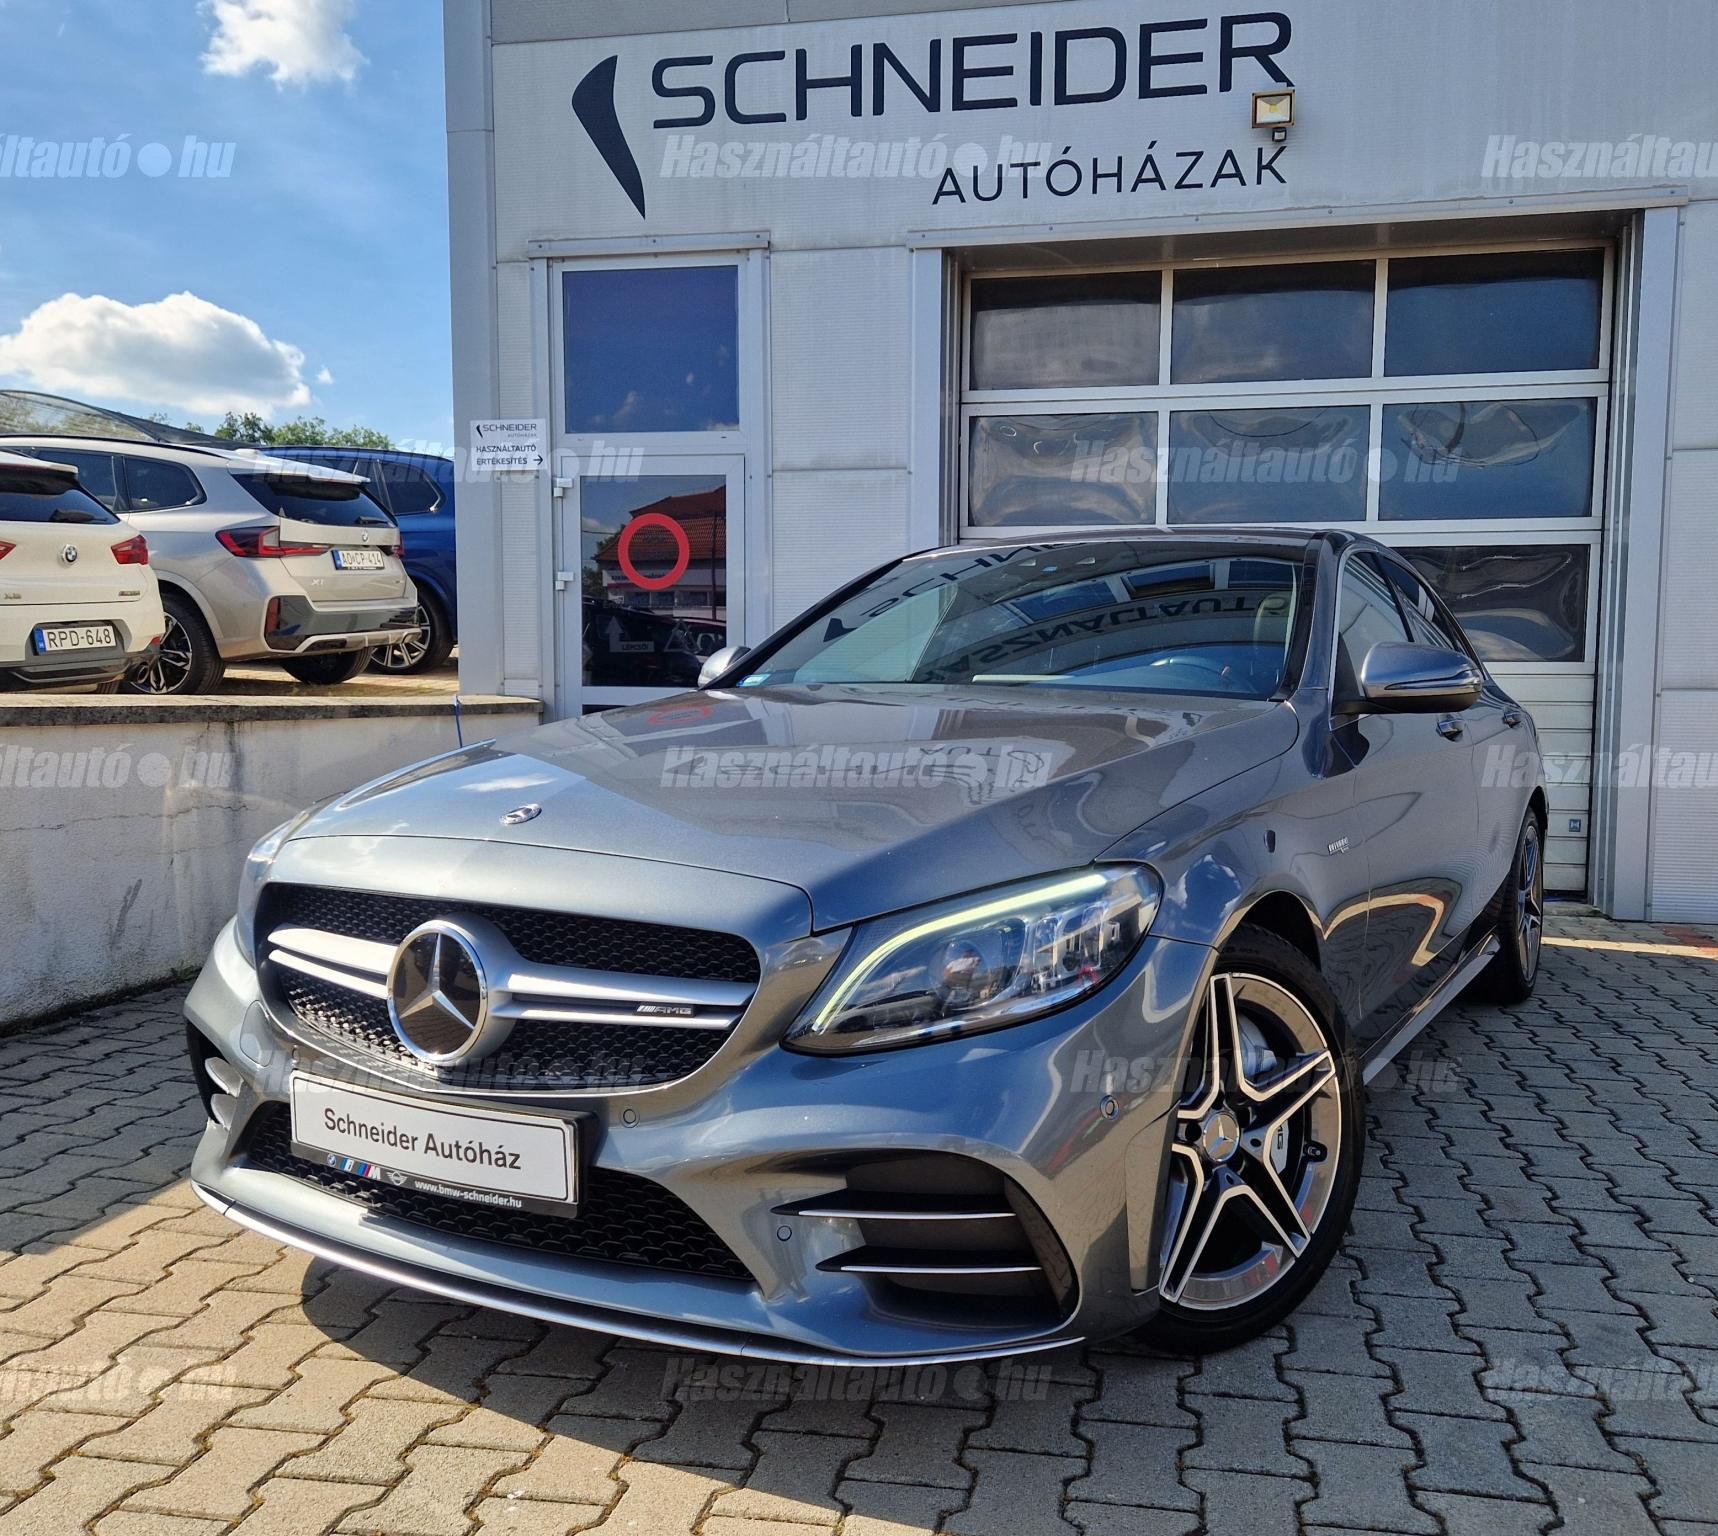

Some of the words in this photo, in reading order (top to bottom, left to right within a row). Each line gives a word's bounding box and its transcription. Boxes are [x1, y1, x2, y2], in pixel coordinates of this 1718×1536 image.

[652, 12, 1294, 128] SCHNEIDER
[931, 140, 1287, 205] AUTÓHÁZAK
[482, 423, 537, 432] SCHNEIDER
[476, 443, 537, 453] HASZNÁLTAUTÓ
[47, 628, 112, 649] RPD-648
[653, 1006, 692, 1015] AMG
[324, 1107, 418, 1152] Schneider
[423, 1132, 522, 1170] Autóház
[414, 1179, 523, 1208] www.bmw-schneider.hu
